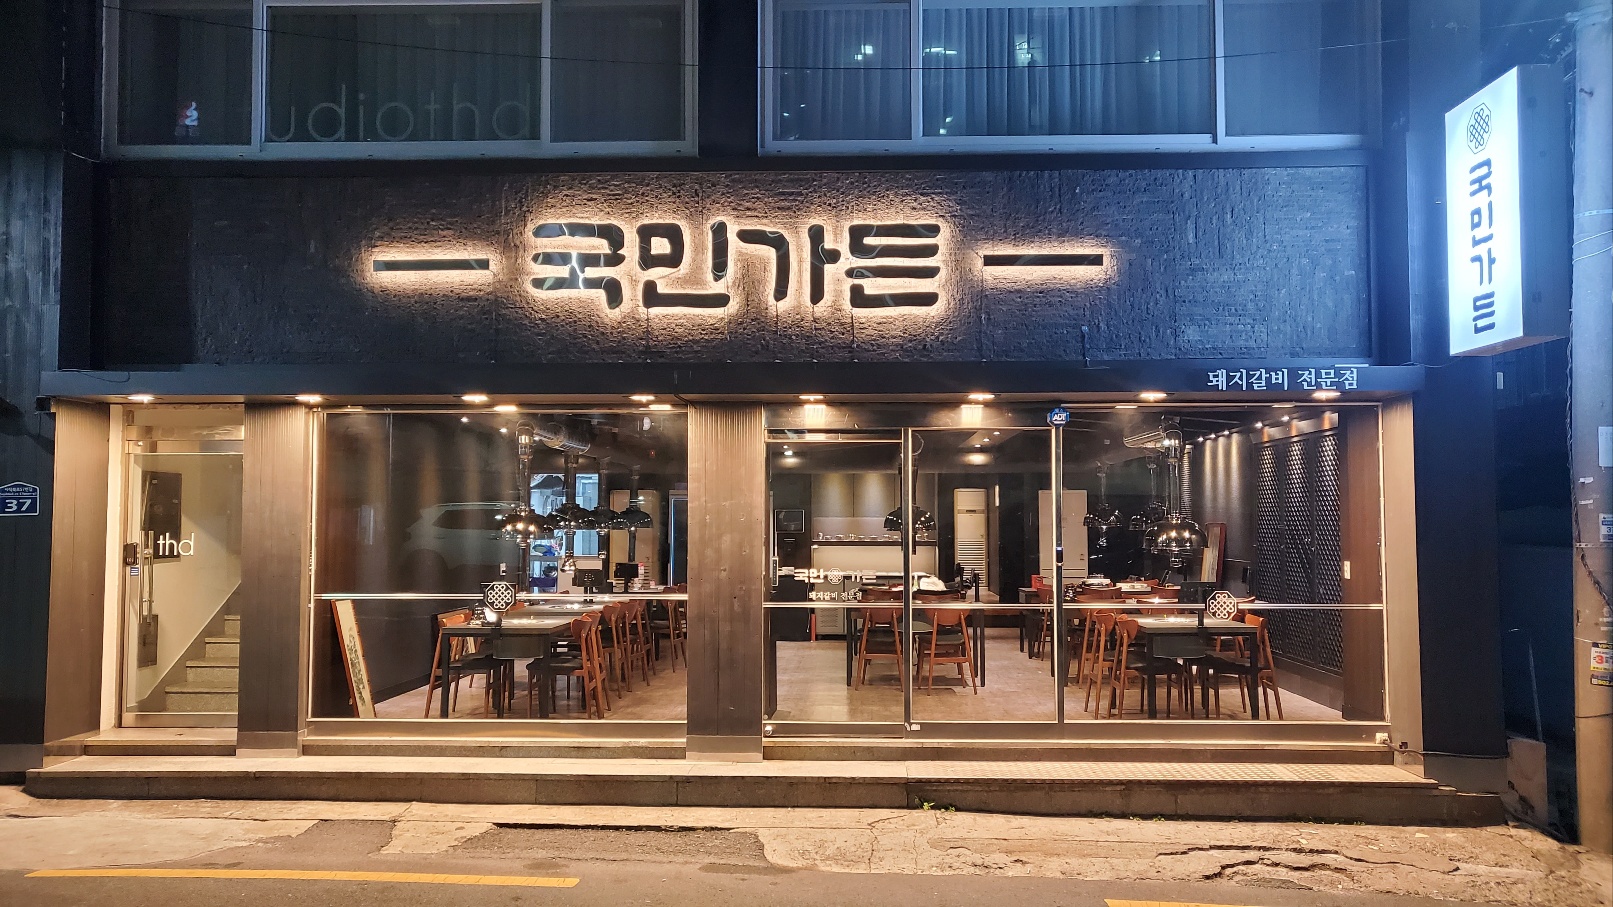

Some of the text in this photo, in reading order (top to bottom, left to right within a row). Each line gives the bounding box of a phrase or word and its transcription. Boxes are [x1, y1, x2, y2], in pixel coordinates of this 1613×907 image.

[1469, 157, 1497, 335] 국민가든
[531, 220, 941, 310] 국민가든
[1207, 368, 1358, 391] 돼지갈비 전문점
[1052, 413, 1067, 421] ADT
[4, 499, 32, 512] 37
[157, 532, 195, 556] thd
